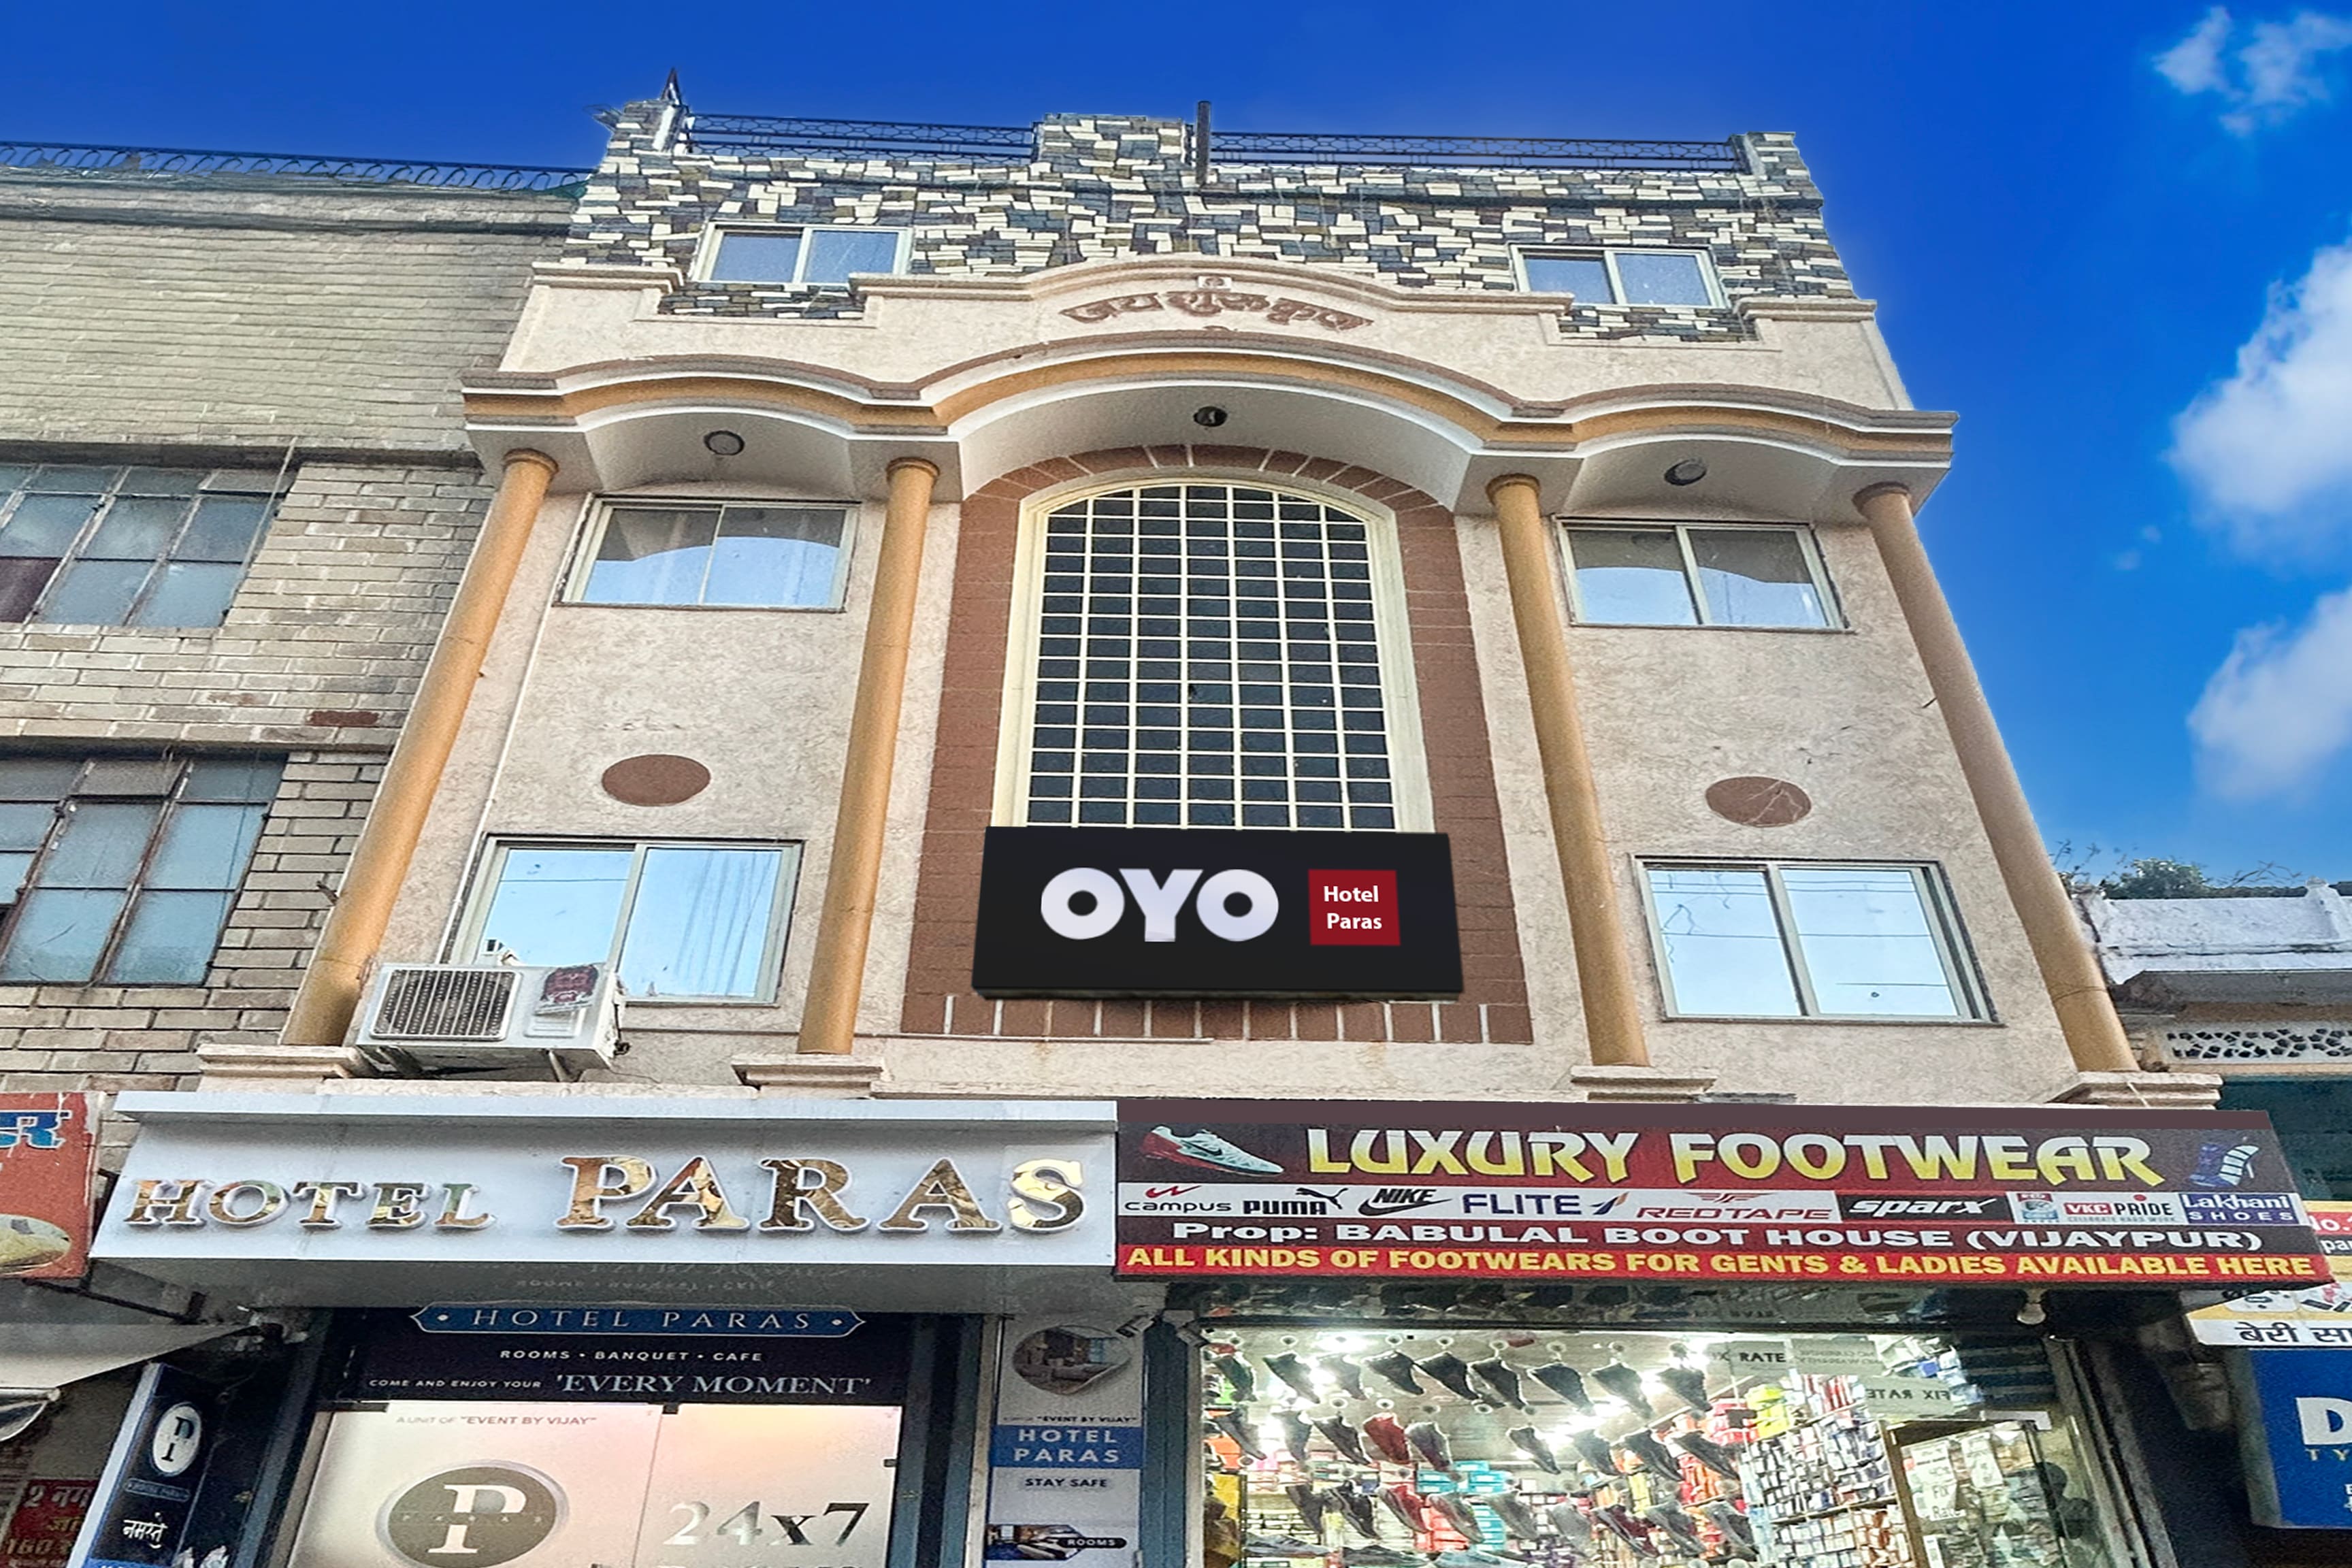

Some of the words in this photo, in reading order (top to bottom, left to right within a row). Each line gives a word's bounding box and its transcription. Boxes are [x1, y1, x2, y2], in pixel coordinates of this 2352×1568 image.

[1323, 885, 1379, 902] Hotel
[1041, 867, 1279, 942] OYO
[1326, 913, 1382, 930] Paras
[1307, 1128, 1639, 1183] LUXURY
[1669, 1132, 2166, 1187] FOOTWEAR
[125, 1179, 498, 1230] HOTEL
[554, 1156, 1088, 1232] PARAS
[1372, 1188, 1437, 1205] NIKE
[2181, 1194, 2290, 1210] Lakhani
[1124, 1200, 1232, 1213] campus
[1243, 1200, 1327, 1215] PUMA
[1463, 1193, 1583, 1215] FLITE
[1849, 1198, 1997, 1218] sparx
[2065, 1203, 2110, 1214] VKC
[2114, 1203, 2174, 1215] PRIDE
[2188, 1211, 2293, 1221] SHOES
[1173, 1222, 1318, 1243] Prop:
[1336, 1224, 1589, 1243] BABULAL
[1603, 1227, 1750, 1245] BOOT
[1765, 1229, 1955, 1247] HOUSE
[1966, 1230, 2263, 1252] (VIJAYPUR)
[1126, 1248, 1196, 1267] ALL
[1206, 1249, 1321, 1268] KINDS
[1330, 1250, 1378, 1268] OF
[1389, 1250, 1616, 1271] FOOTWEARS
[1627, 1253, 1698, 1272] FOR
[1710, 1254, 1829, 1274] GENTS
[1839, 1256, 1869, 1274] &
[1881, 1256, 2007, 1275] LADIES
[2016, 1256, 2210, 1275] AVAILABLE
[2215, 1257, 2316, 1275] HERE
[472, 1309, 630, 1327] HOTEL
[662, 1311, 810, 1330] PARAS
[500, 1350, 570, 1360] ROOMS
[594, 1351, 689, 1361] BANQUET
[713, 1352, 763, 1361] CAFE
[1739, 1352, 1786, 1362] RATE
[416, 1379, 446, 1388] AND
[504, 1380, 542, 1388] YOUR
[522, 1416, 542, 1425] BY
[1018, 1429, 1117, 1443] HOTEL
[1013, 1448, 1120, 1463] PARAS
[1024, 1478, 1066, 1488] STAY
[1070, 1478, 1108, 1488] SAFE
[662, 1501, 870, 1547] 24x7
[1067, 1538, 1117, 1548] ROOMS
